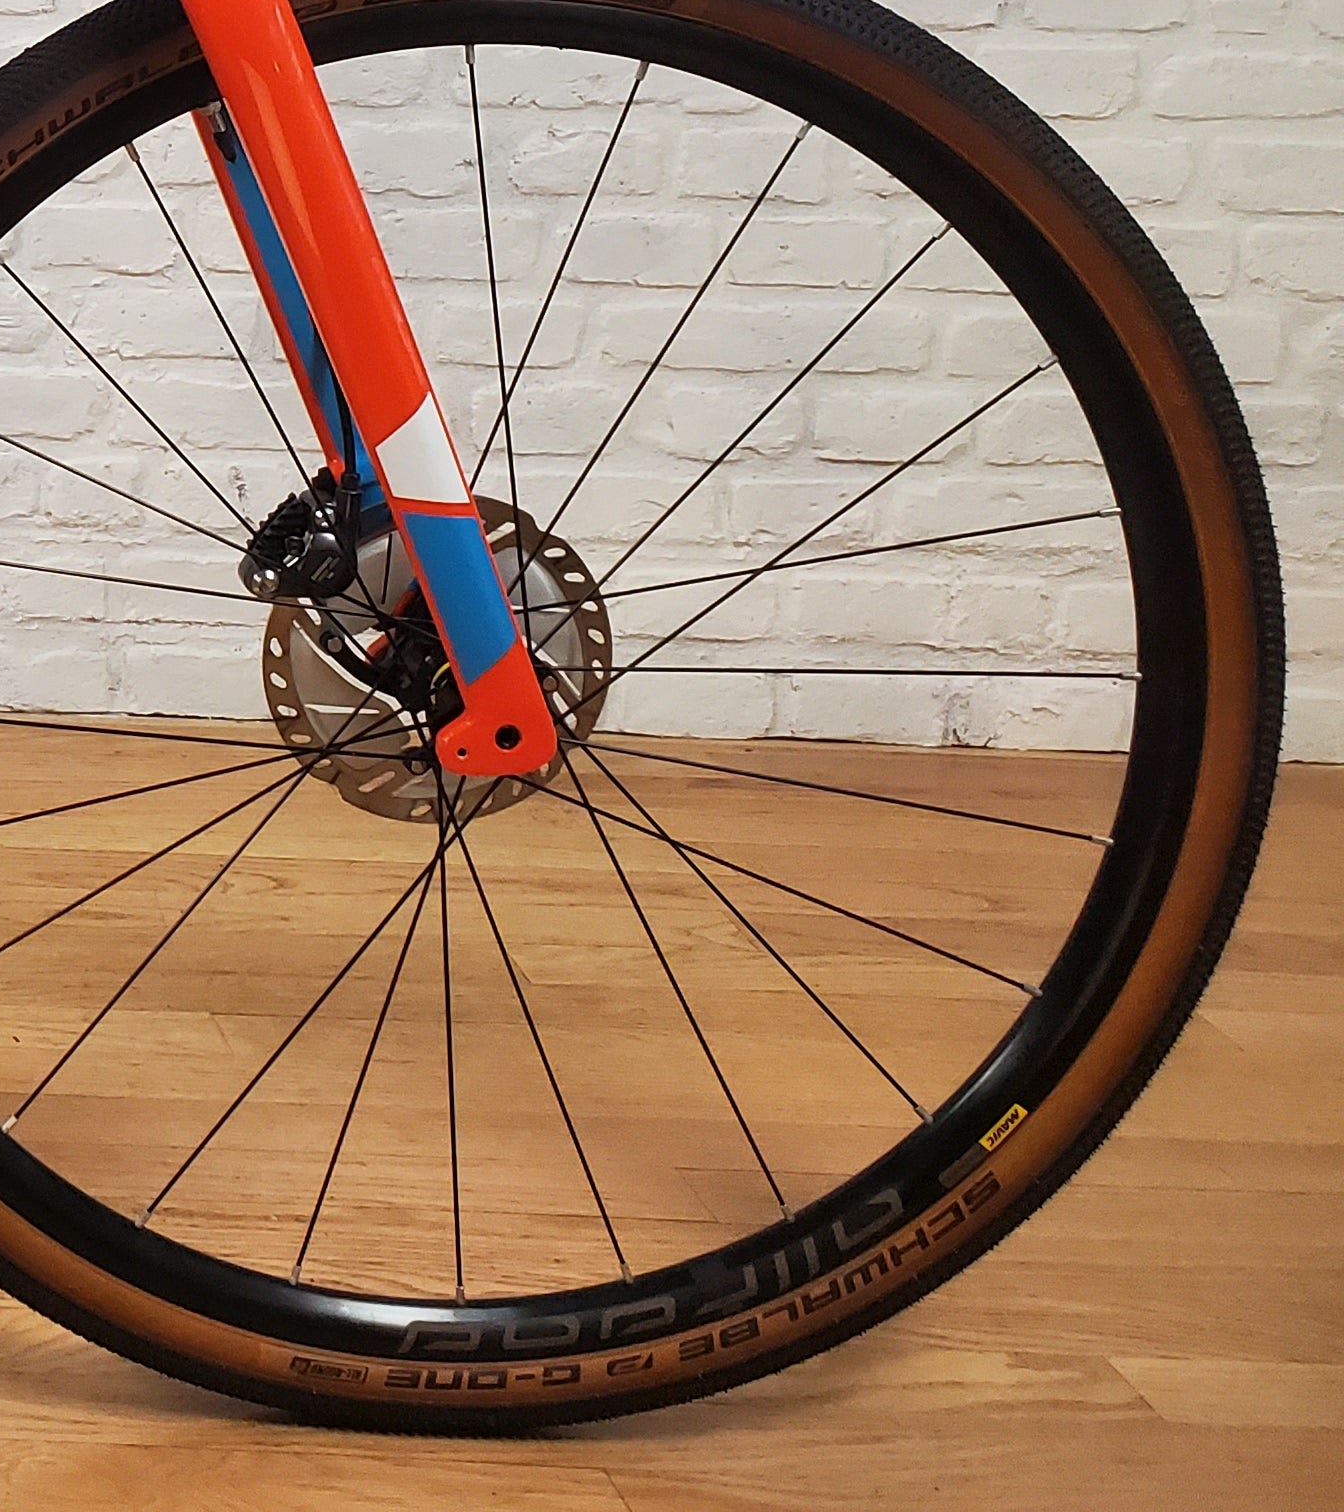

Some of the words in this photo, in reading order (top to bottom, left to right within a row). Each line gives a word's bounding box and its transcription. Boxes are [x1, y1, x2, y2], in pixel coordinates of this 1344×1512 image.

[983, 1106, 1023, 1147] MAVIC
[679, 1171, 1002, 1362] SCHWALBE
[384, 1365, 582, 1391] G-ONE
